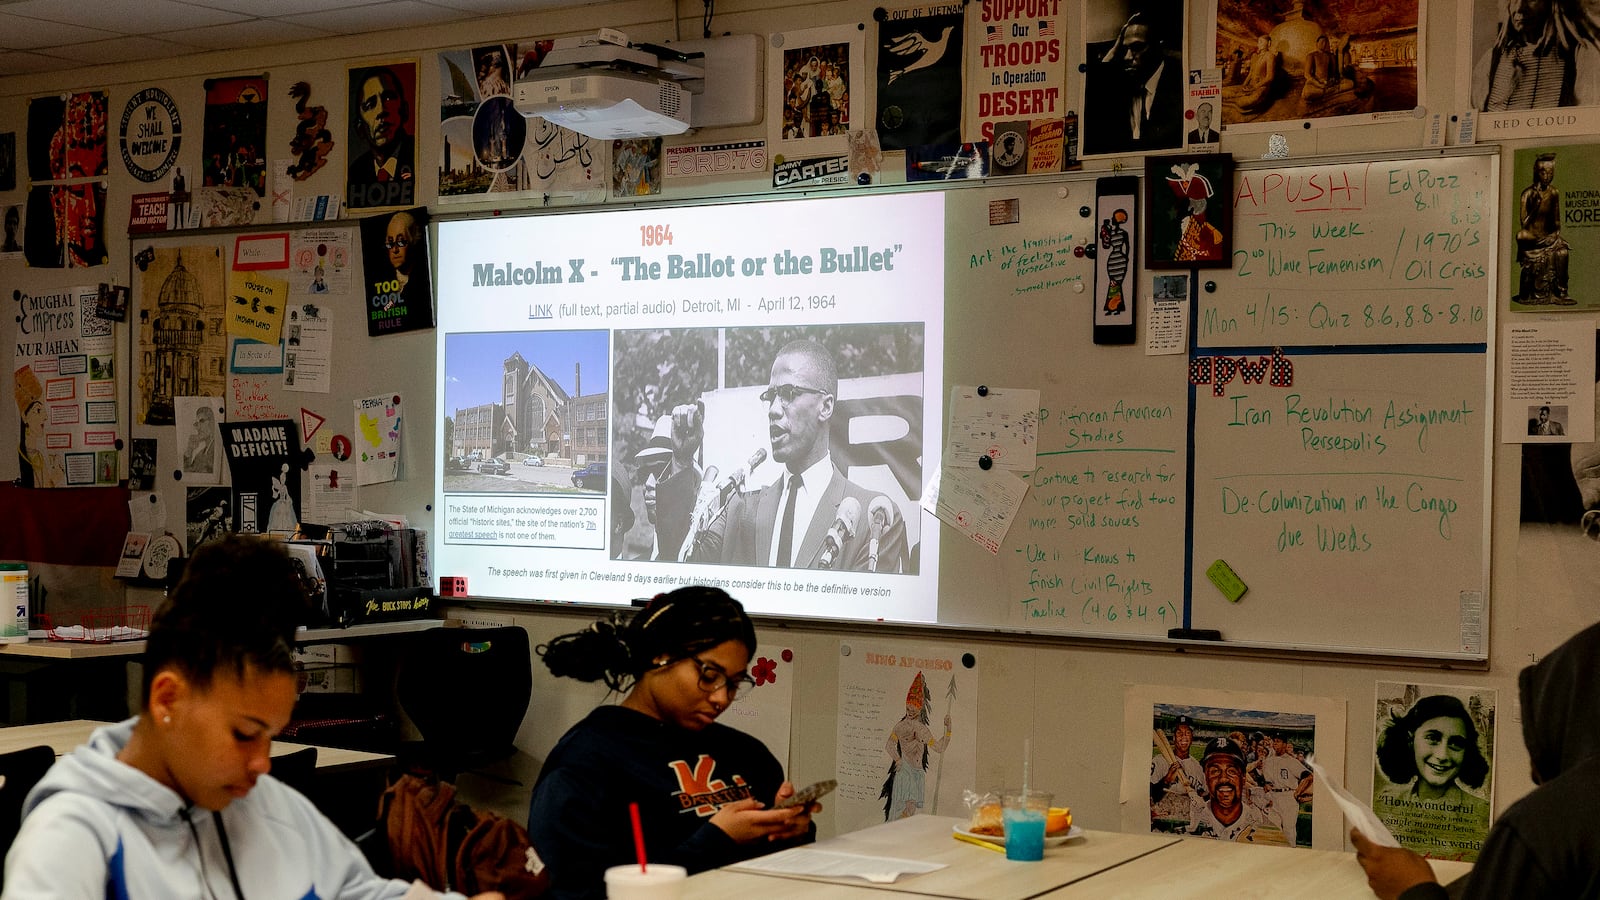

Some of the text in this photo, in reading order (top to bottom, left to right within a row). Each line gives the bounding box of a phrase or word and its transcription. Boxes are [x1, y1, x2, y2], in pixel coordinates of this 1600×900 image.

[893, 5, 964, 20] OUT OF VIETNAM
[981, 0, 1059, 22] SUPPORT
[1012, 22, 1030, 38] Our
[980, 39, 1060, 68] TROOPS
[992, 69, 1047, 88] In Operation
[979, 87, 1059, 118] DESERT
[145, 105, 157, 120] WE
[137, 121, 164, 138] SHALL
[1493, 115, 1577, 129] RED CLOUD
[131, 139, 168, 156] OVERCOME
[667, 146, 699, 155] PRESIDENT
[667, 152, 731, 175] FORD
[775, 161, 803, 171] JIMMY
[1031, 158, 1060, 170] NOW!
[349, 180, 413, 208] HOPE
[1234, 170, 1360, 208] APUSH
[139, 203, 166, 216] TEACH
[1565, 199, 1600, 208] MUSEUM
[640, 224, 673, 247] 1964
[1259, 222, 1297, 242] This
[1416, 228, 1480, 254] 1970's
[472, 260, 563, 287] Malcolm
[568, 258, 585, 283] X
[667, 252, 735, 280] Ballot
[741, 257, 767, 277] or
[773, 249, 813, 275] the
[1268, 249, 1302, 277] Wave
[1405, 260, 1486, 281] Oil Crisis
[374, 280, 400, 295] TOO
[29, 294, 75, 311] MUGHAL
[372, 294, 405, 309] COOL
[528, 295, 836, 319] LINK (full text, partial audio) Detroit, MI April 12, 1964
[371, 307, 408, 321] BRITISH
[1203, 307, 1238, 338] Mon
[1308, 301, 1350, 330] Quiz
[255, 320, 271, 330] LAND
[378, 318, 403, 330] RULE
[16, 339, 80, 357] NUR JAHAN
[1189, 345, 1294, 397] apwh
[362, 398, 383, 409] PERSIA
[1228, 394, 1473, 453] Iran Revolution Assignment
[231, 426, 288, 443] MADAME
[1301, 427, 1387, 455] Persepolis
[231, 440, 289, 458] DEFICIT!
[1034, 464, 1176, 487] Continue research for
[1060, 488, 1176, 514] project find two
[449, 505, 461, 513] The
[462, 505, 479, 514] State
[479, 505, 487, 514] of
[486, 506, 515, 516] Michigan
[516, 507, 562, 516] acknowledges
[579, 507, 598, 517] 2,700
[1355, 493, 1368, 511] in
[1376, 485, 1399, 510] the
[1407, 482, 1458, 541] Congo
[448, 518, 597, 530] official the site of the nation's 7th
[448, 531, 473, 540] greatest
[474, 531, 498, 541] speech
[499, 531, 505, 539] is
[530, 532, 538, 540] of
[538, 532, 557, 541] them.
[1278, 521, 1372, 552] due Weds
[1084, 547, 1120, 565] Knows
[488, 566, 891, 598] The speech was first given in Cleveland 9 days earlier but historians consider this to be the definitive version
[1029, 568, 1153, 605] finish Civil Rights
[382, 602, 396, 611] BUCK
[397, 600, 411, 610] STOPS
[1021, 597, 1066, 621] Timeline
[900, 656, 953, 671] AFONSO
[1414, 801, 1474, 814] wonderful
[1386, 817, 1475, 834] single moment before
[1431, 837, 1480, 851] the world
